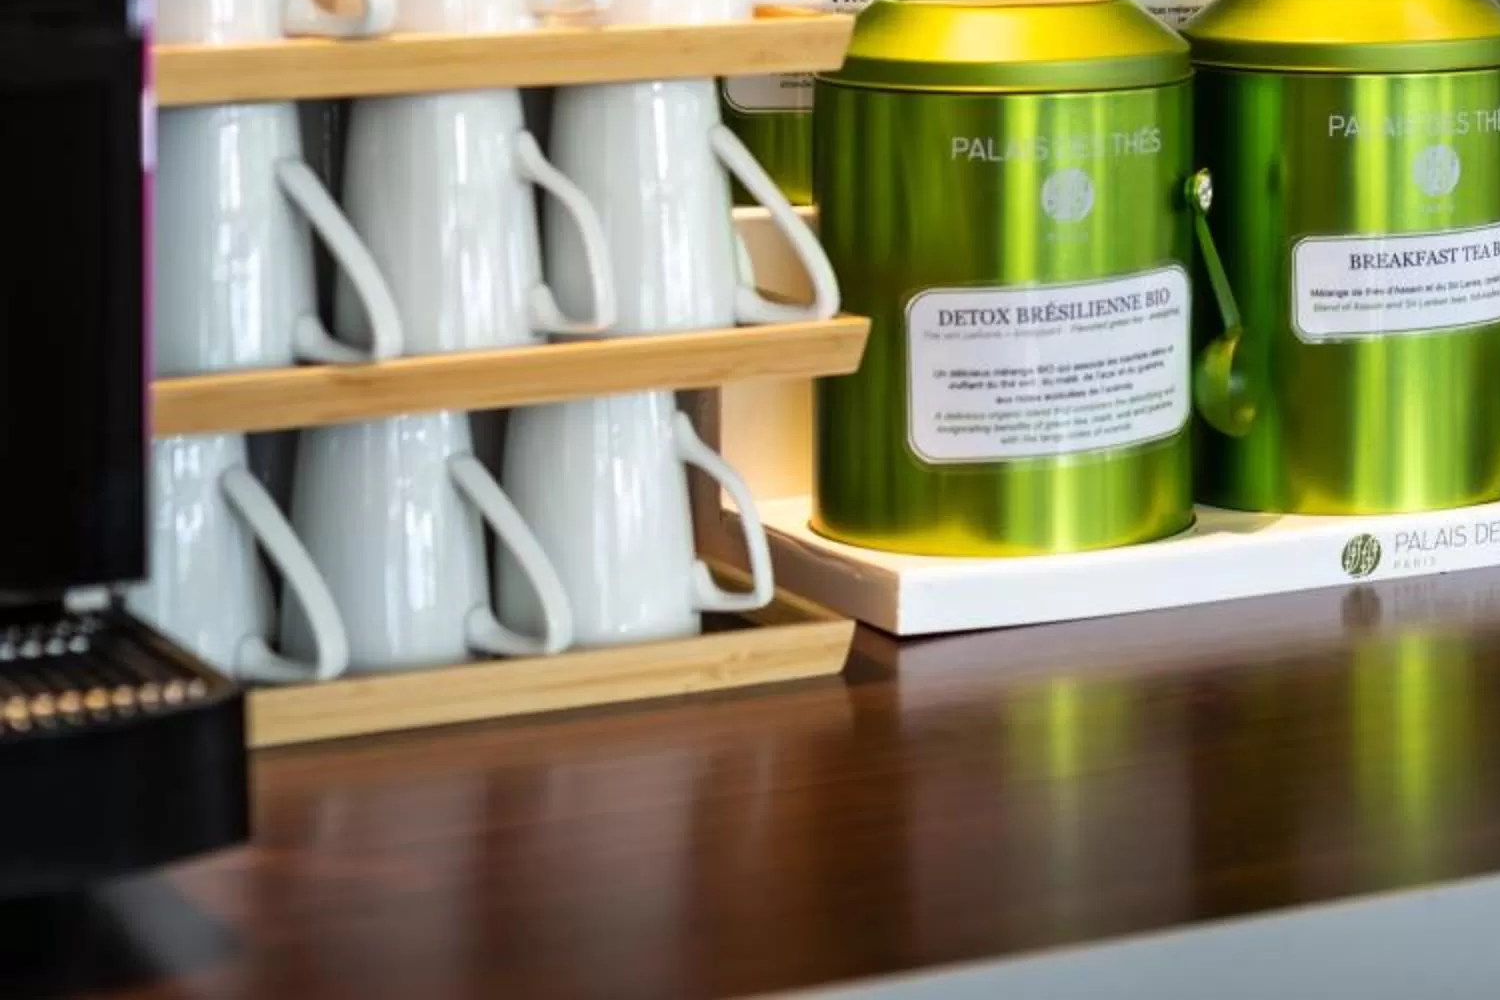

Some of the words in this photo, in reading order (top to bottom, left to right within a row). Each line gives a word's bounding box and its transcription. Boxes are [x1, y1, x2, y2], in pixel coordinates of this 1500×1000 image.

[1328, 114, 1417, 138] PAAIS
[1111, 124, 1163, 158] THÉS
[1349, 248, 1459, 270] BREAKFAST
[1462, 243, 1491, 262] TEA
[938, 306, 1010, 327] DETOX
[1015, 293, 1142, 325] BRÉSILIENNE
[1145, 287, 1171, 309] BIO
[1394, 524, 1468, 552] PALAIS
